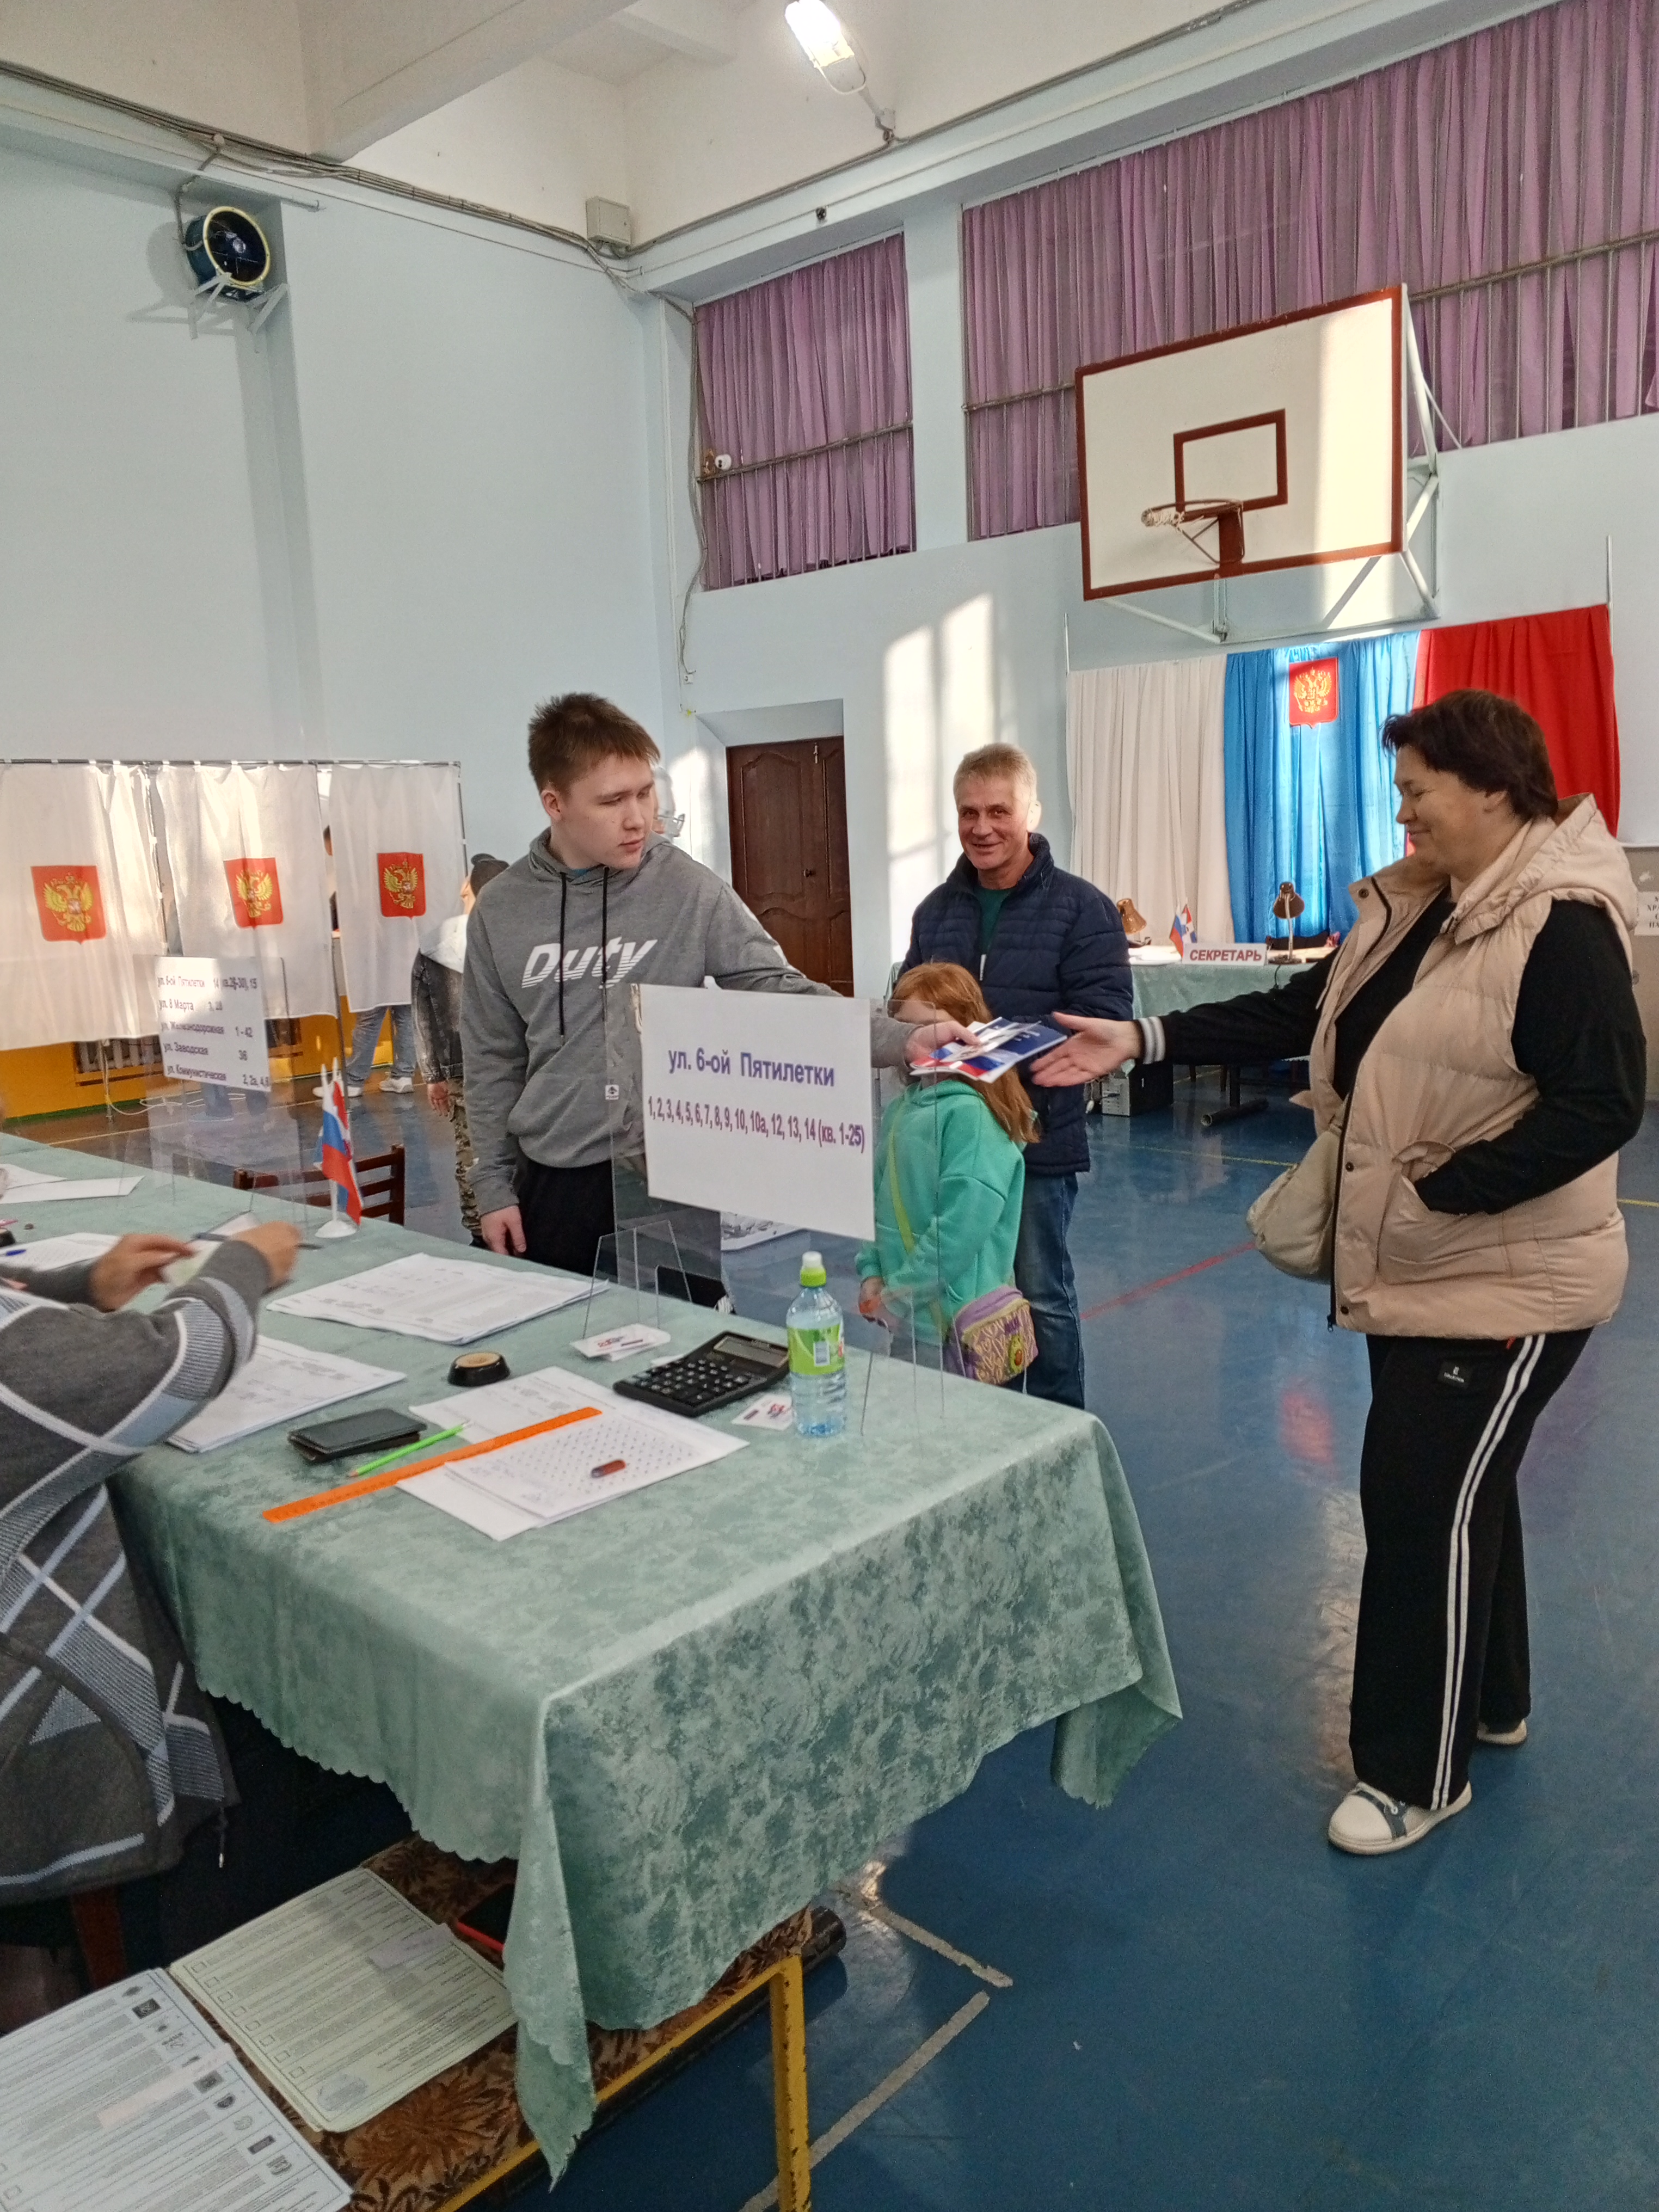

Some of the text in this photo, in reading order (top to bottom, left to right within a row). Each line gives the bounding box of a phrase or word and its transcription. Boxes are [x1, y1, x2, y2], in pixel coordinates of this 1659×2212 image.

[521, 937, 658, 988] Duty
[1190, 949, 1262, 962] СЕКРЕТАРЬ
[174, 999, 194, 1013] Марта
[668, 1047, 834, 1086] ул. 6-ой Пятилетки
[648, 1096, 655, 1120] 1,
[657, 1097, 665, 1121] 2,
[666, 1098, 674, 1122] 3,
[676, 1099, 684, 1124] 4,
[686, 1101, 693, 1126] 5,
[695, 1103, 703, 1127] 6,
[704, 1104, 712, 1129] 7,
[715, 1105, 722, 1130] 8,
[724, 1107, 732, 1132] 9,
[735, 1108, 748, 1134] 10,
[771, 1113, 785, 1140] 12,
[788, 1115, 801, 1142] 13,
[804, 1117, 815, 1140] 14
[819, 1119, 835, 1147] (кв.
[839, 1122, 864, 1153] 1-25)
